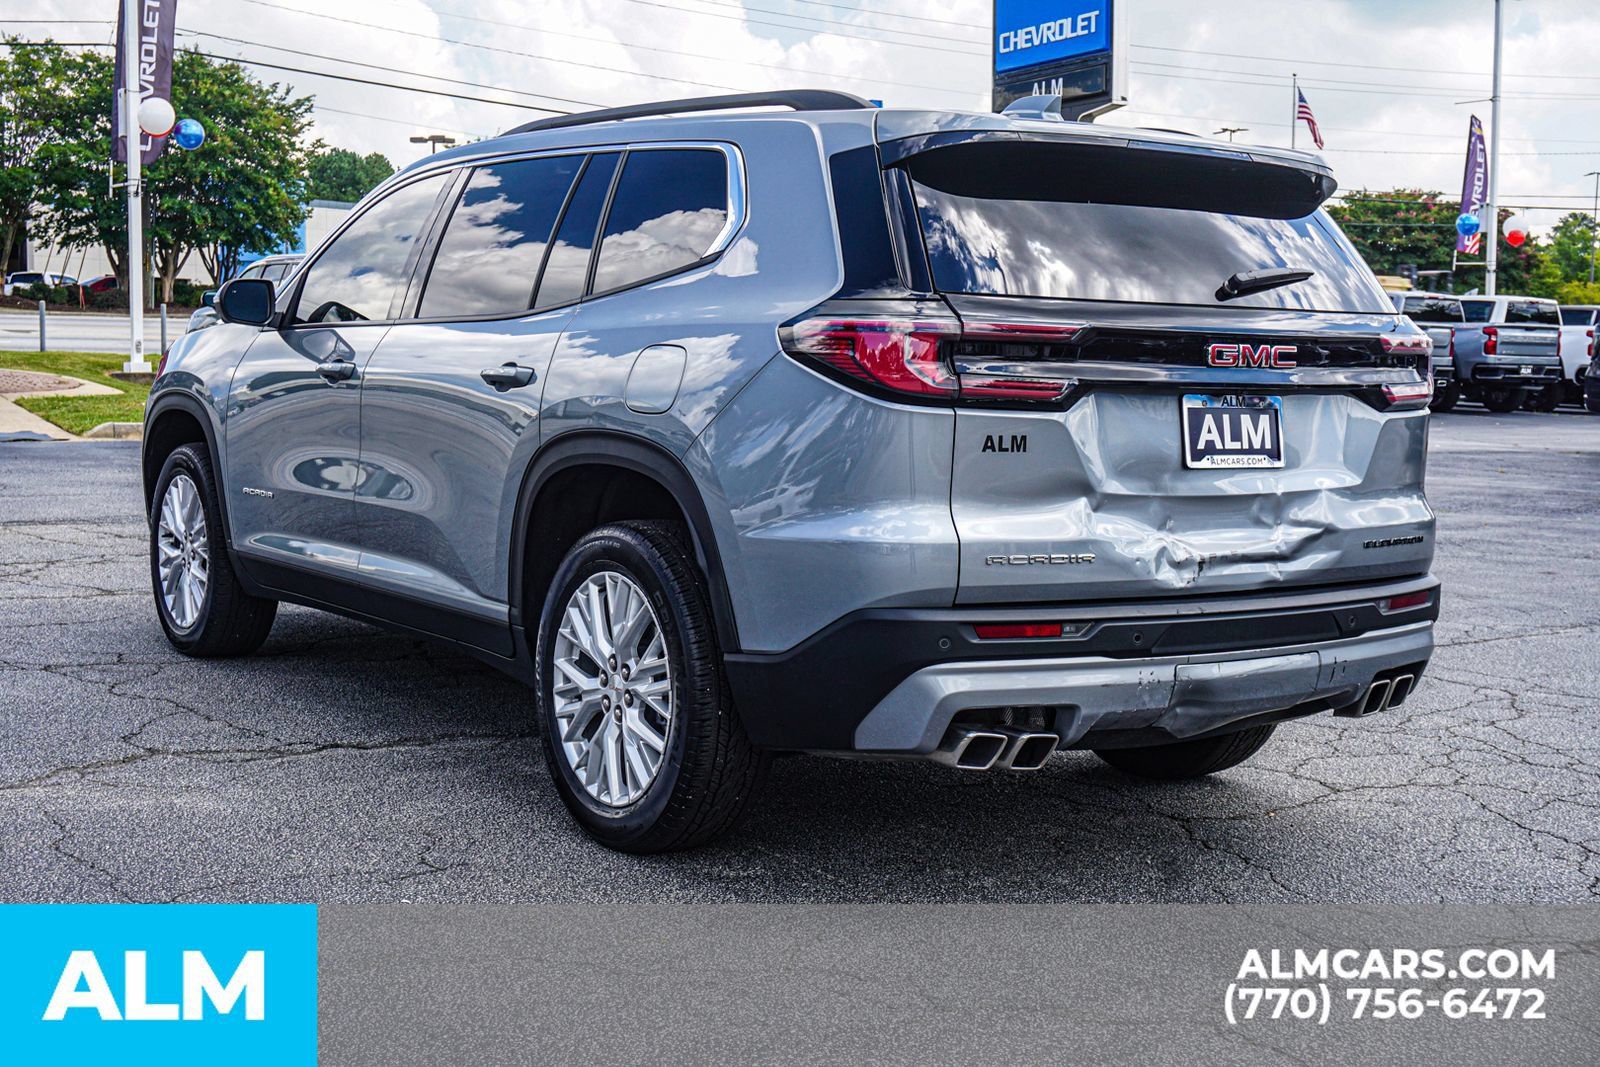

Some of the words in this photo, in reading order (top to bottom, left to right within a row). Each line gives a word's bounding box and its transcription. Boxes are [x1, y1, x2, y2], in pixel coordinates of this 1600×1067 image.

[999, 10, 1100, 53] CHEVROLET
[1209, 343, 1298, 368] GMC
[1222, 396, 1246, 408] ALM
[1197, 414, 1272, 449] ALM
[982, 435, 1027, 452] ALM
[1211, 457, 1263, 466] ALMCARS.COM
[986, 554, 1096, 565] ACADIA
